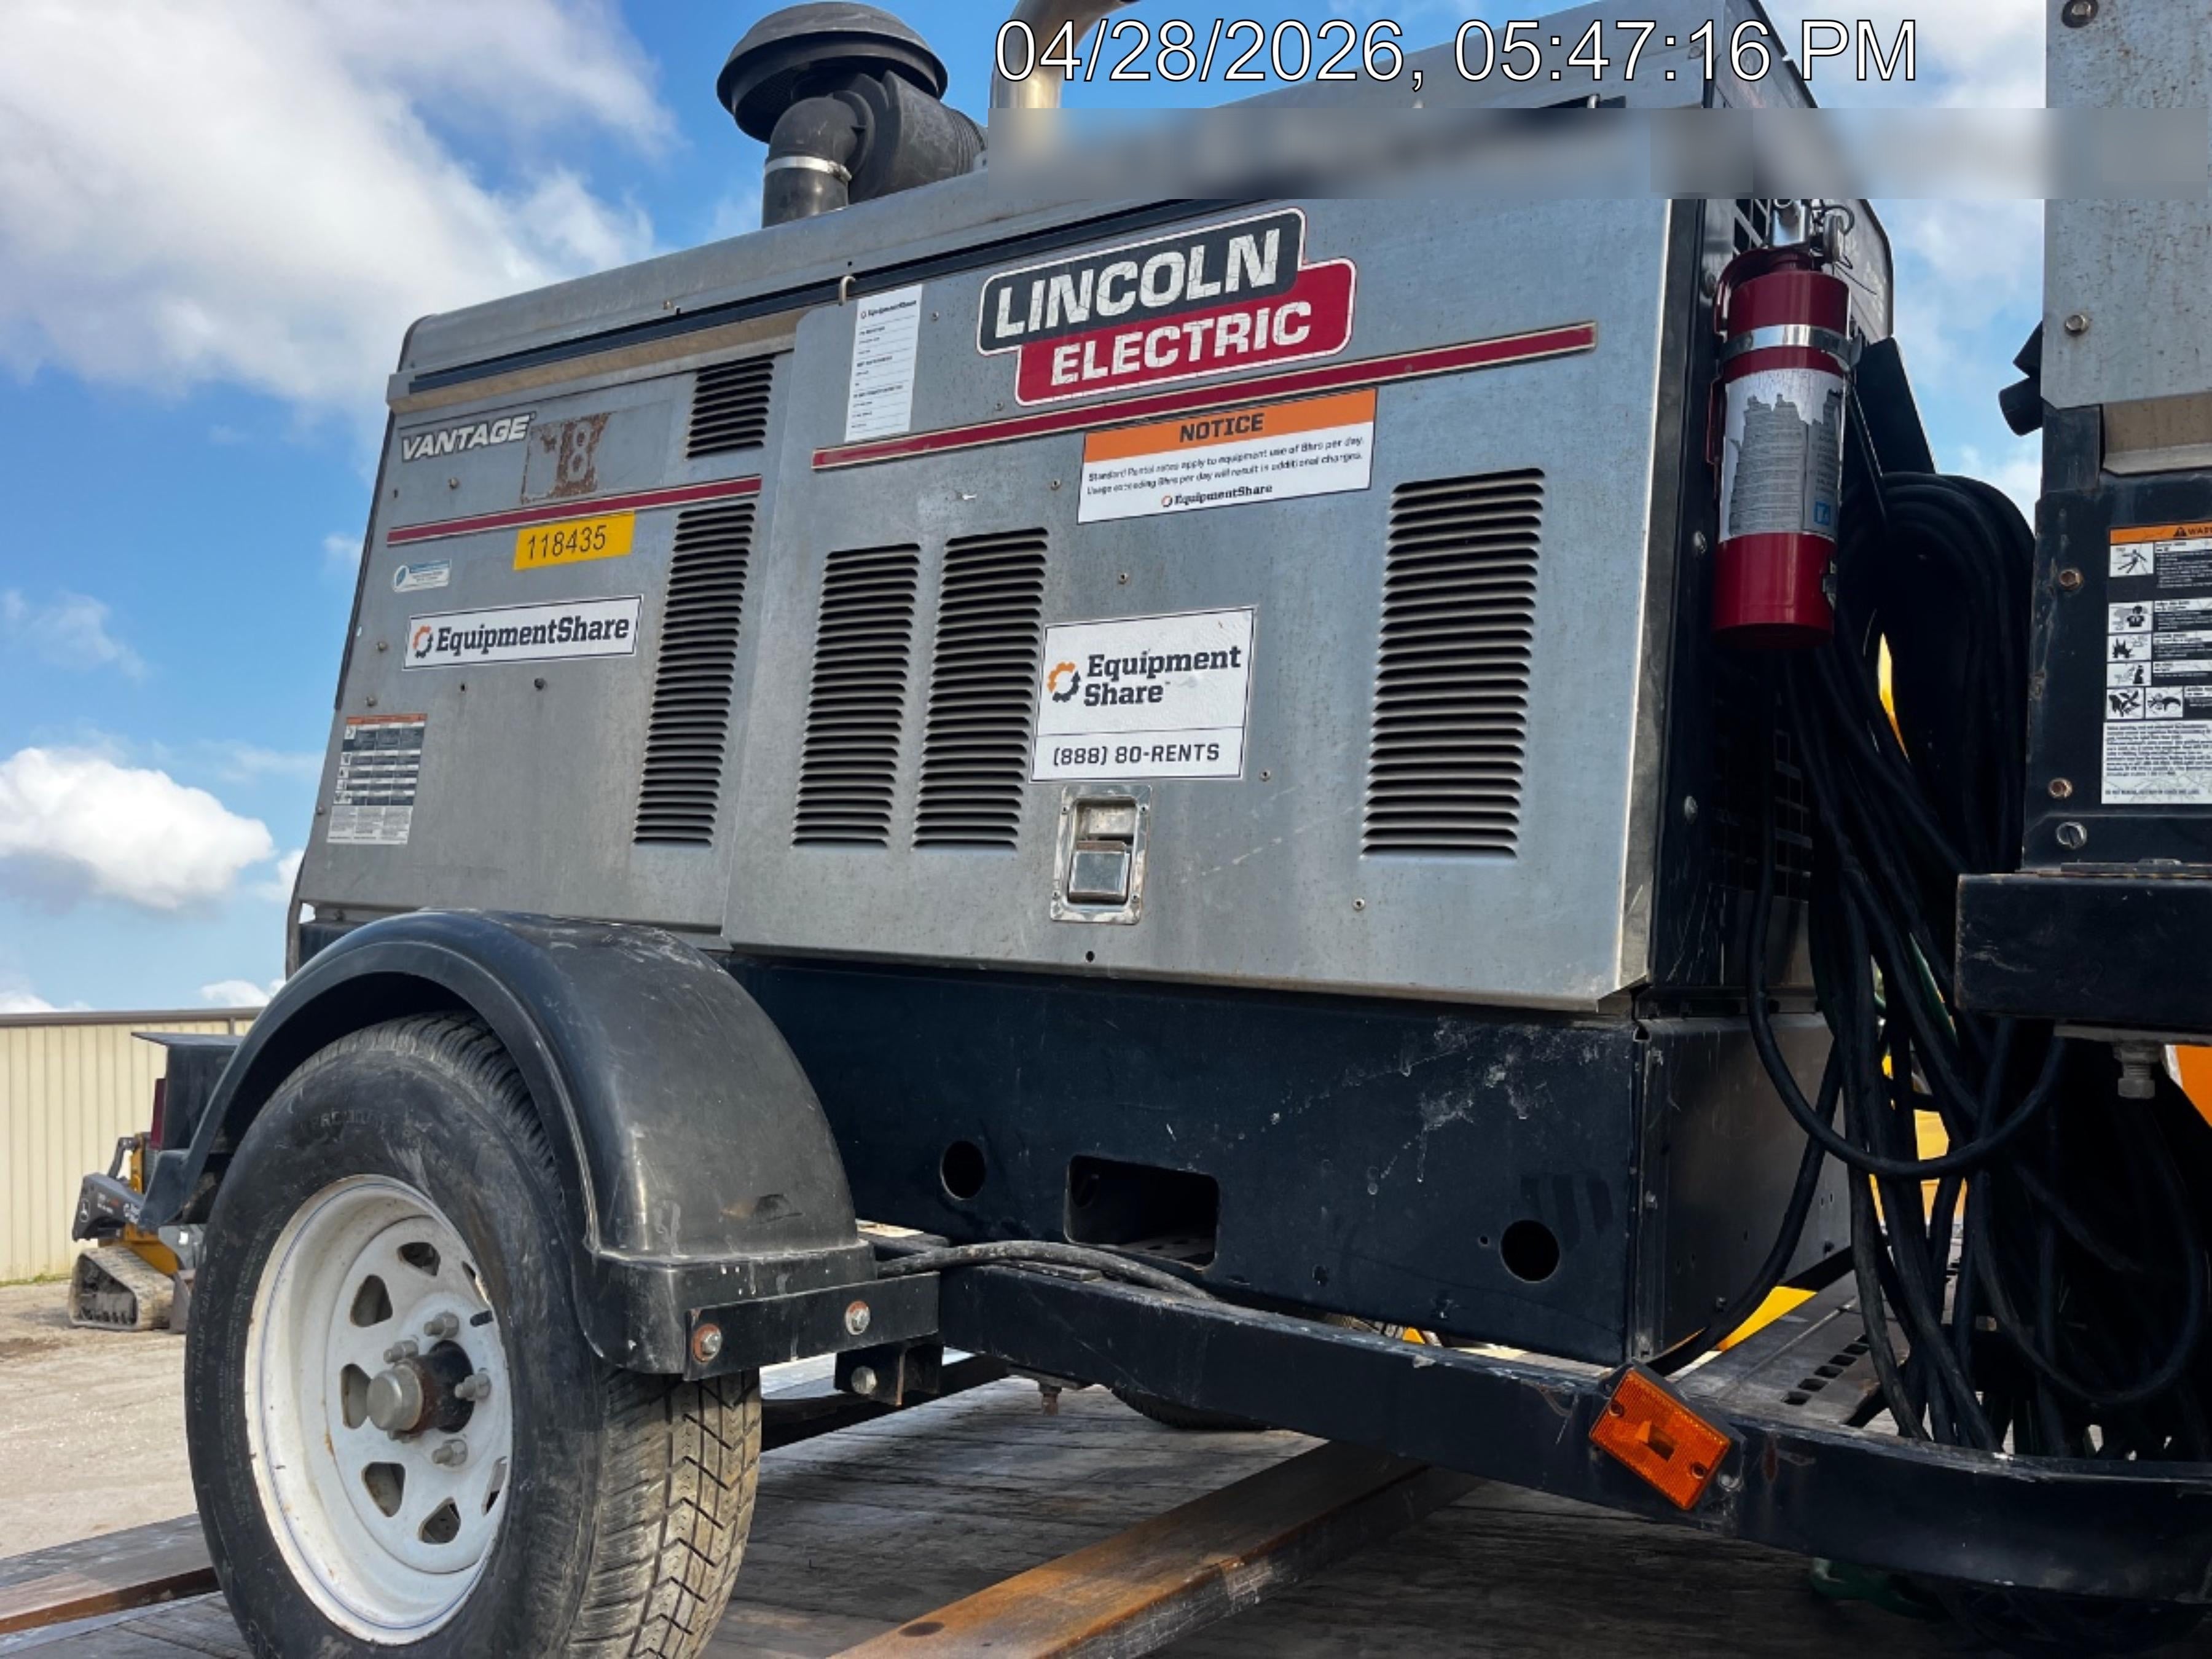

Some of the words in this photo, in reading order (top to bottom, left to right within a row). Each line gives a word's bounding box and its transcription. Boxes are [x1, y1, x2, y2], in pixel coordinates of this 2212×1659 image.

[994, 228, 1281, 339] LINCOLN
[1050, 301, 1312, 386] ELECTRIC
[402, 412, 531, 462] VANTAGE
[1179, 413, 1265, 443] NOTICE
[1089, 468, 1127, 482] Standard
[1181, 459, 1205, 469] apply
[1207, 457, 1217, 465] to
[1218, 449, 1267, 464] equipment
[1269, 448, 1287, 457] use
[1288, 444, 1300, 455] of
[1325, 439, 1343, 450] per
[1179, 474, 1194, 485] per
[1196, 471, 1214, 482] day
[1214, 467, 1230, 479] will
[1231, 465, 1259, 477] result
[1271, 457, 1319, 471] additional
[1174, 484, 1273, 506] EquipmentShare
[527, 524, 608, 560] 118435
[2187, 526, 2212, 535] WAR
[436, 615, 630, 657] EquipmentShare
[1086, 645, 1242, 683] Equipment
[1083, 682, 1164, 707] Share
[1053, 746, 1108, 767] (888)
[1114, 742, 1220, 764] 80-RENTS
